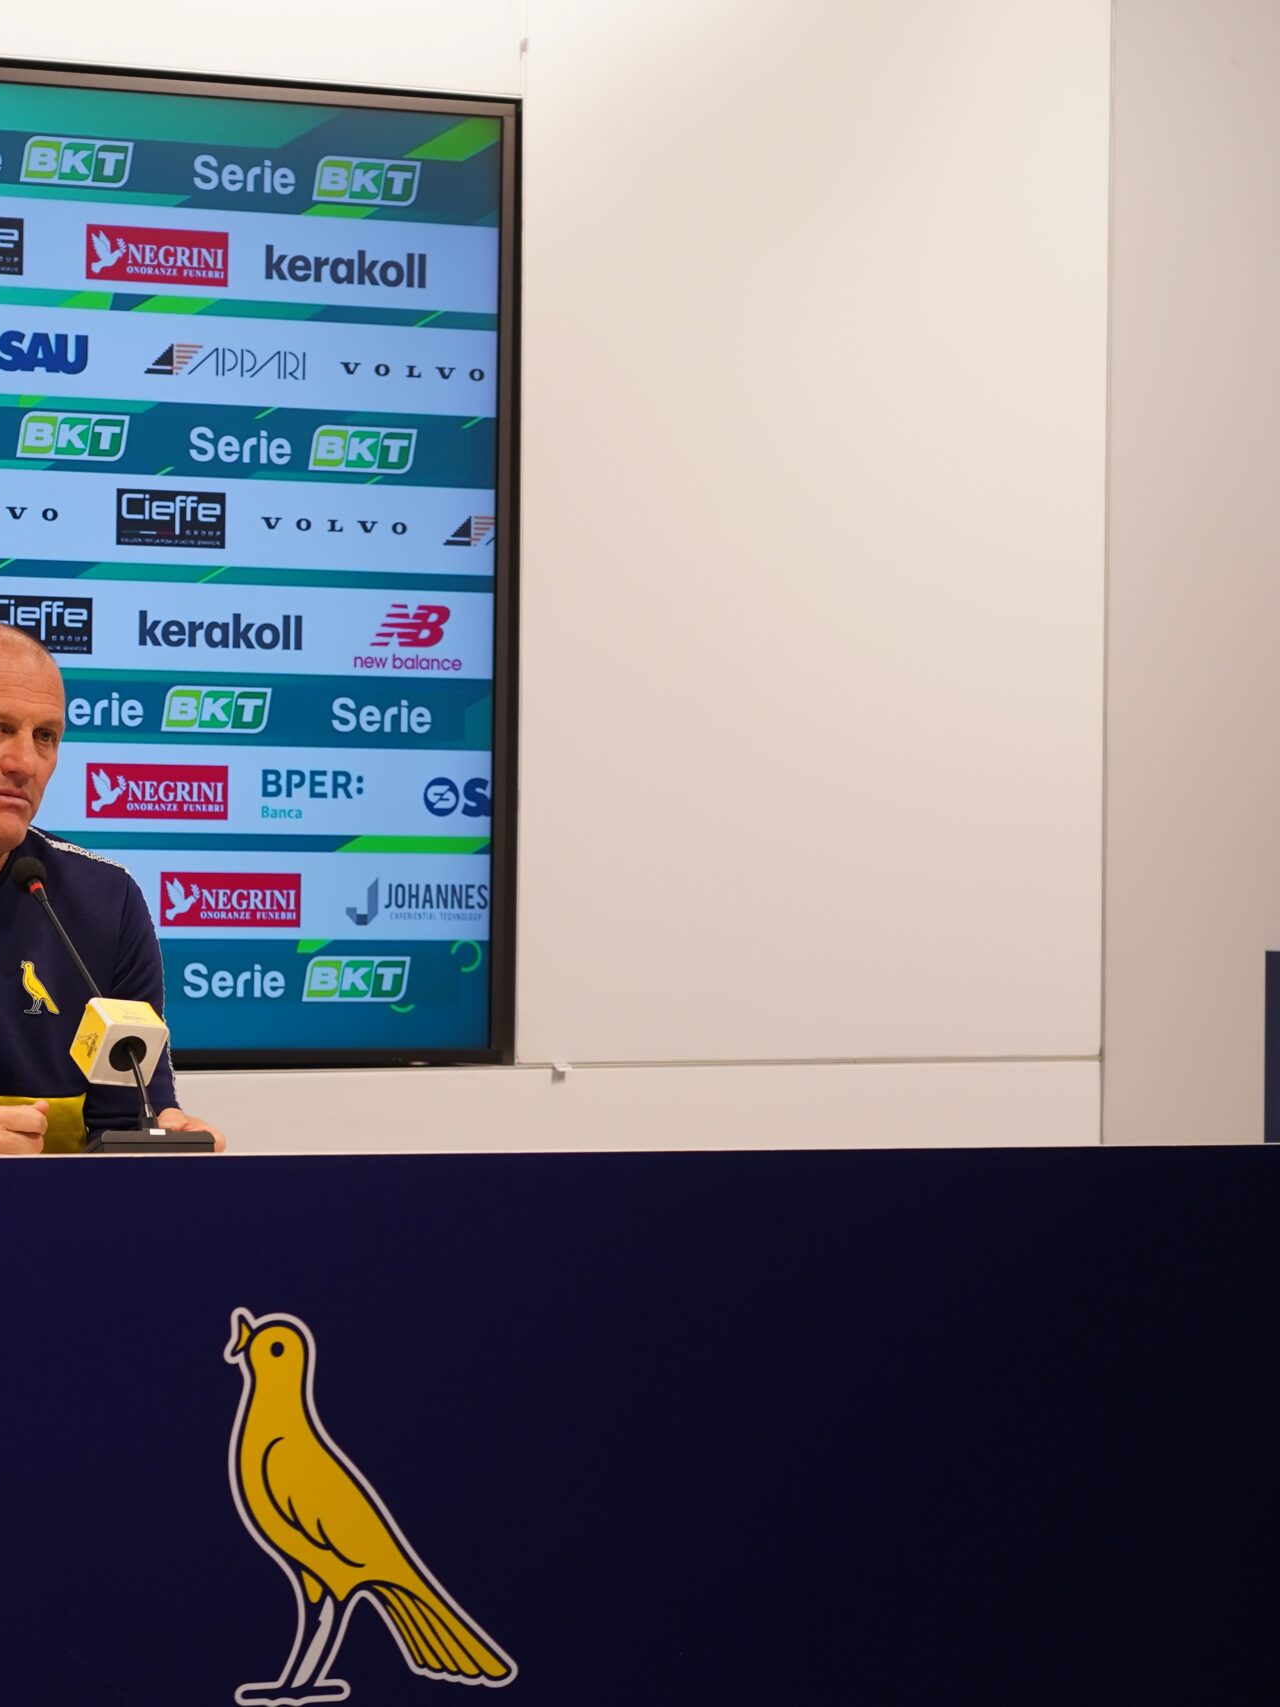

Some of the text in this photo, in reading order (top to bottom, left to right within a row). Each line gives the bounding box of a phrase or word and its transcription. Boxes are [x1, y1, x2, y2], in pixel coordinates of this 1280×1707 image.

[27, 146, 126, 183] BKT
[194, 155, 414, 201] Serie BKT
[126, 266, 224, 278] ONORANZE FUNEBRI
[127, 244, 223, 272] NEGRINI
[265, 245, 426, 288] kerakoll
[340, 362, 484, 381] VOLVO
[23, 422, 124, 457] BKT
[190, 427, 411, 470] Serie BKT
[122, 494, 221, 535] Cieffe
[261, 517, 407, 535] VOLVO
[139, 610, 302, 650] kerakoll
[354, 654, 462, 671] new balance
[68, 692, 265, 730] erie BKT
[332, 697, 431, 733] Serie
[128, 781, 223, 802] NEGRINI
[262, 769, 363, 799] BPER:
[127, 803, 223, 812] ONORANZE FUNEBRI
[261, 806, 302, 819] Banca
[202, 889, 295, 909] NEGRINI
[385, 884, 488, 910] JOHANNES
[200, 911, 250, 919] ONORANZE
[184, 963, 406, 998] Serie BKT
